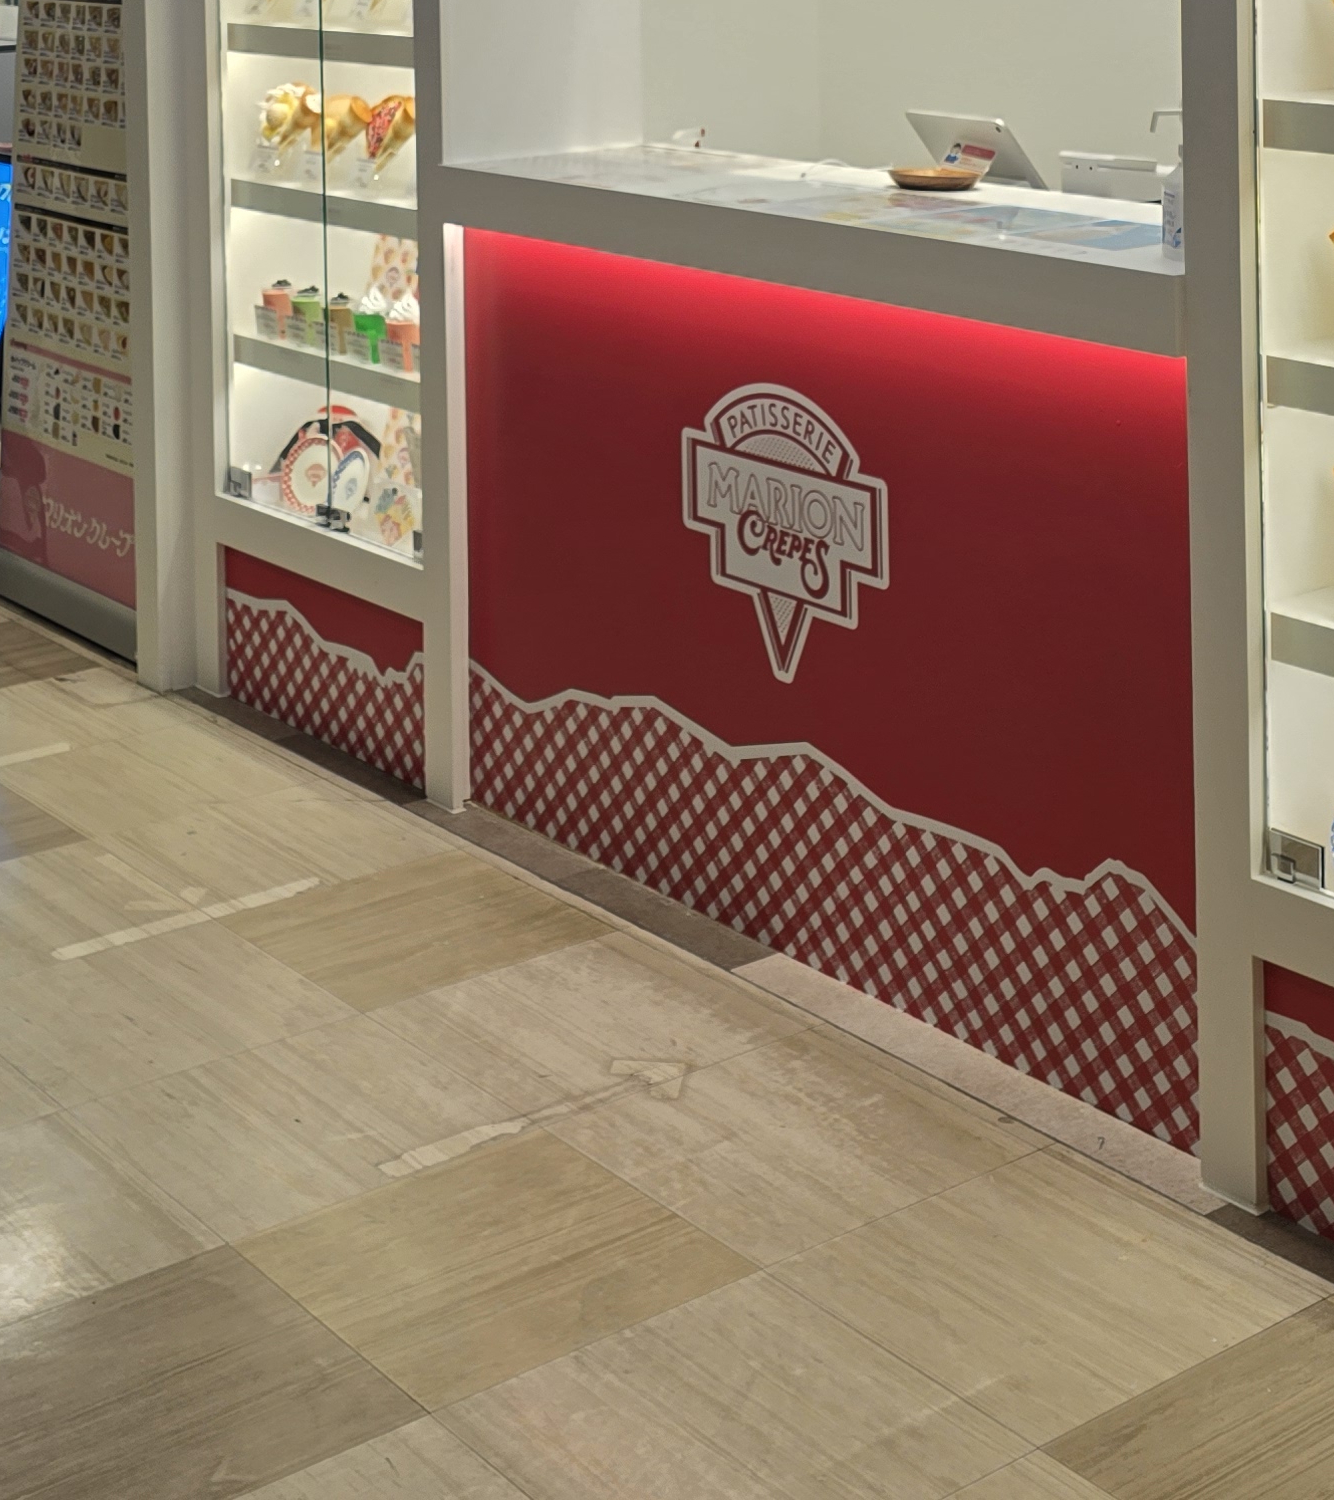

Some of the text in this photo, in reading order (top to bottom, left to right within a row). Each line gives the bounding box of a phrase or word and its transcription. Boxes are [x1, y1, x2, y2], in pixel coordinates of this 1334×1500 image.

[726, 403, 837, 465] PATISSERIE
[707, 461, 865, 552] MARION
[737, 509, 831, 600] CREPES
